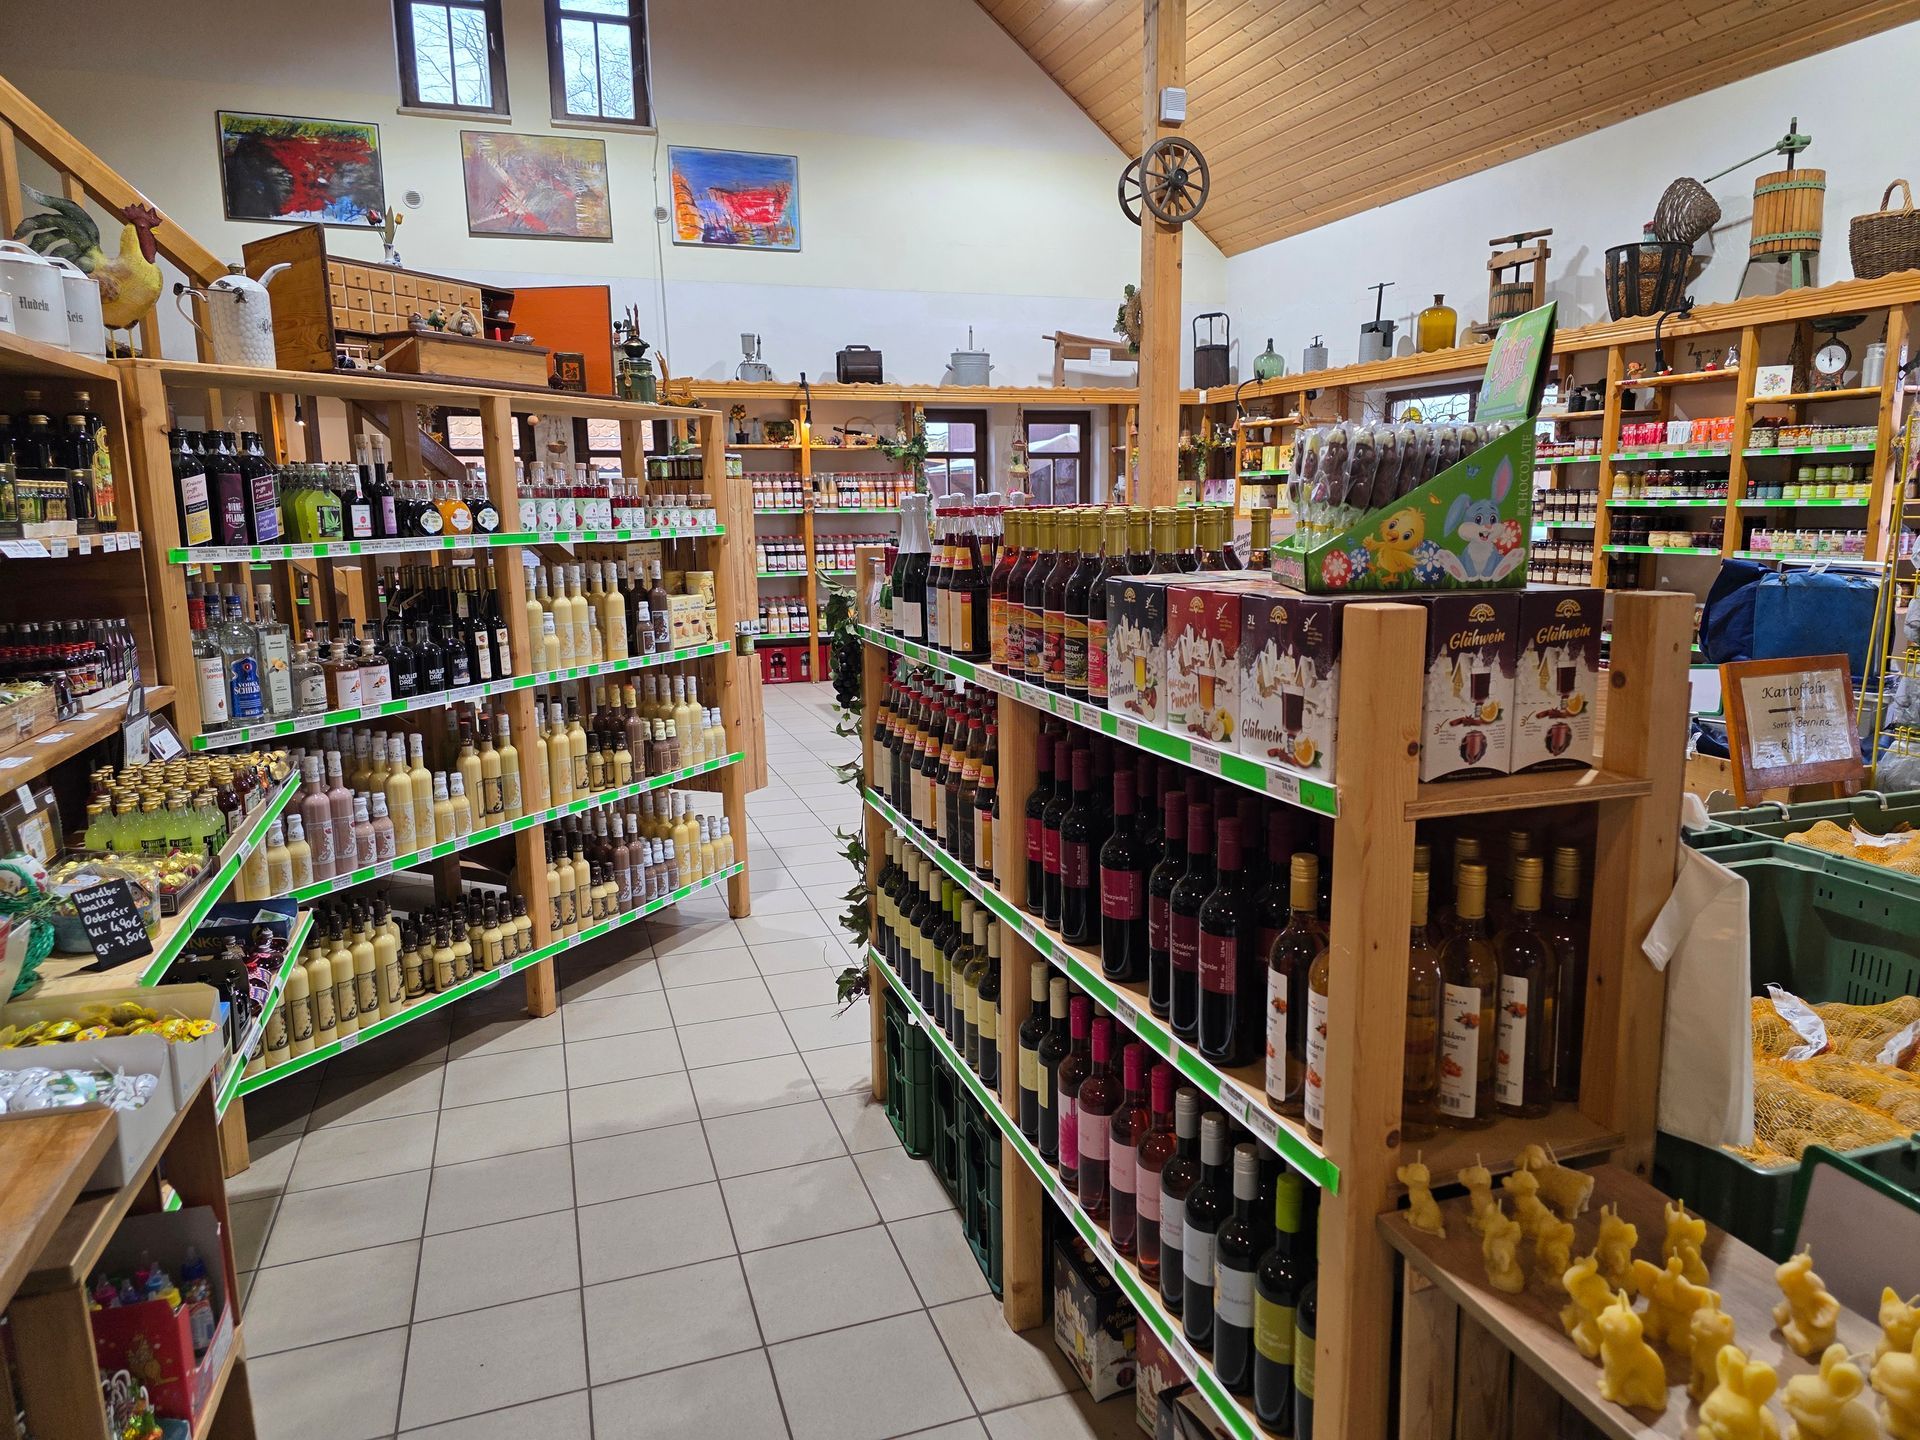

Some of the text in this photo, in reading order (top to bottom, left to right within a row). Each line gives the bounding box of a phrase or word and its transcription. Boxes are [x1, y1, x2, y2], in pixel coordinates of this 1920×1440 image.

[1519, 434, 1532, 510] CHOCOLATE
[1450, 628, 1506, 650] Glühwein
[1536, 624, 1592, 645] Glühwein
[1109, 682, 1134, 698] Glühwein
[1761, 680, 1826, 700] Kartoffeln
[1241, 718, 1283, 744] Glühwein
[1795, 716, 1833, 728] Bernina
[75, 886, 120, 904] Handbe-
[81, 898, 115, 913] malte
[84, 907, 129, 925] Ostereier
[110, 915, 141, 932] 4,90€
[96, 928, 147, 955] gr. 7,50€
